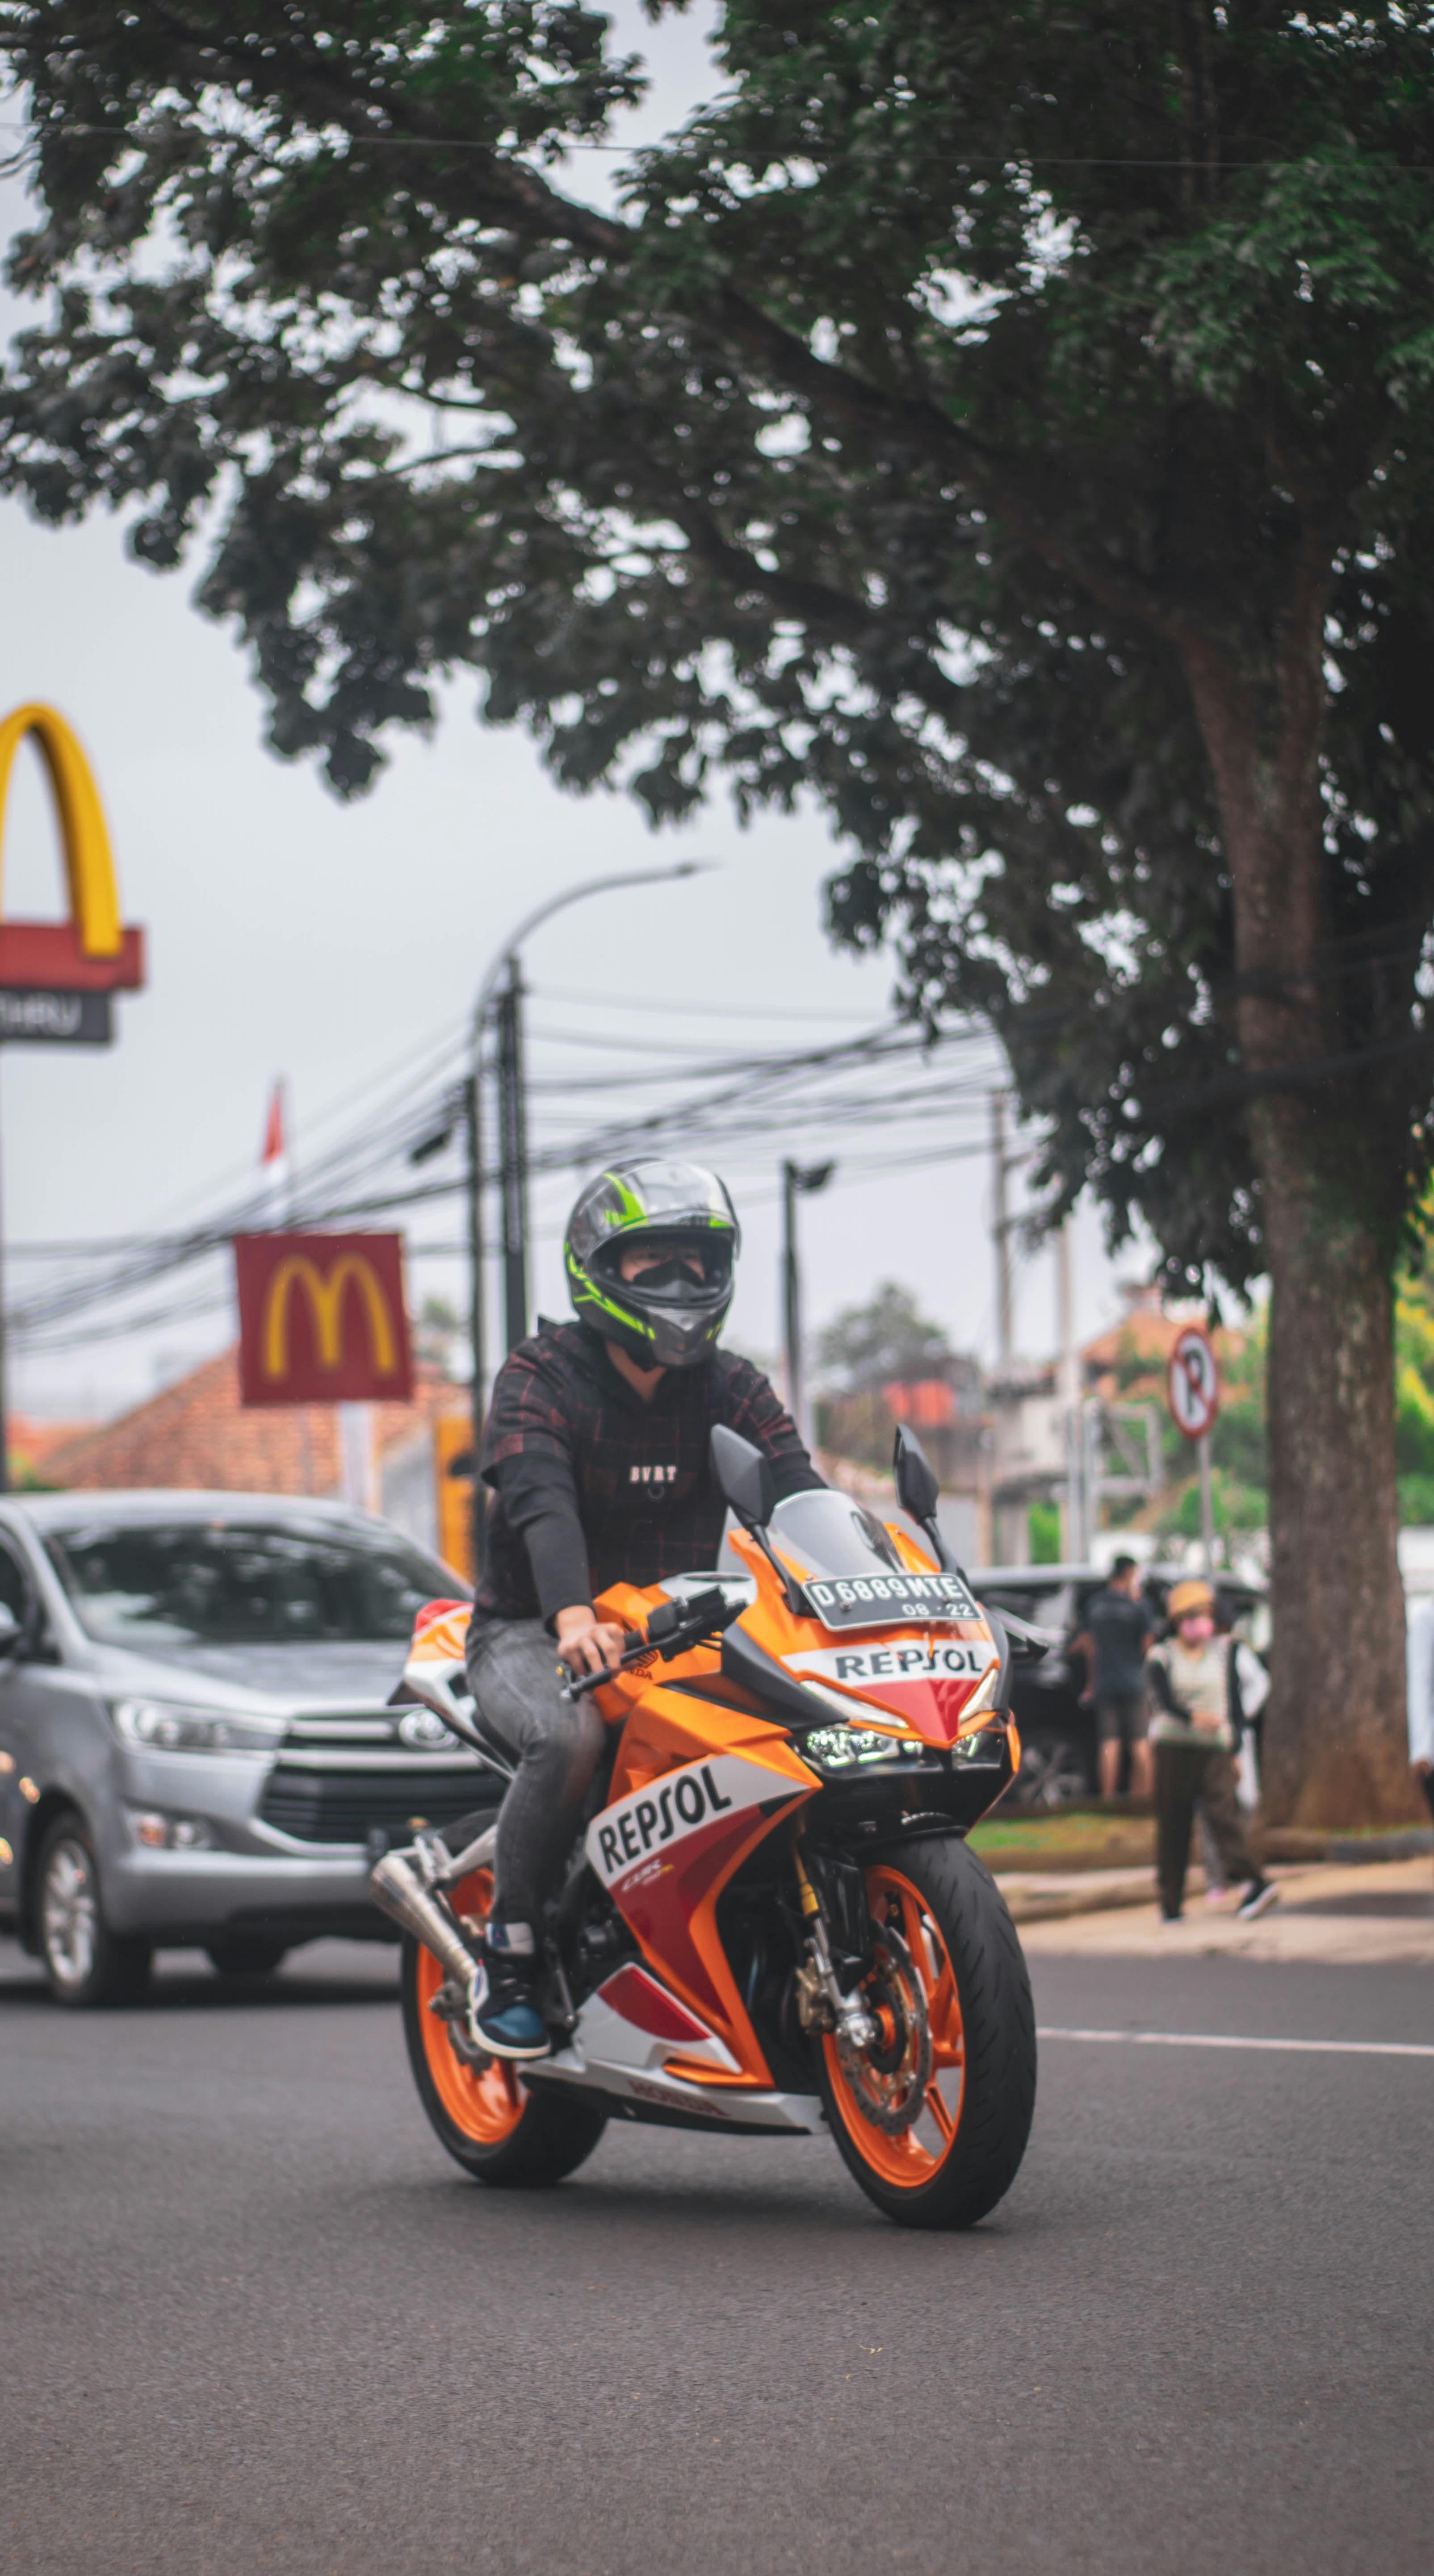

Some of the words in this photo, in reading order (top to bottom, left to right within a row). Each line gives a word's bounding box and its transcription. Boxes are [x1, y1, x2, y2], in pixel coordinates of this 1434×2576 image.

[630, 1466, 677, 1482] BVRT
[810, 1584, 835, 1606] D
[834, 1576, 909, 1602] 6889
[905, 1577, 964, 1599] MTE
[901, 1603, 930, 1616] 08
[946, 1604, 974, 1616] 22
[835, 1648, 983, 1679] REPSOL
[599, 1765, 733, 1874] REPSOL
